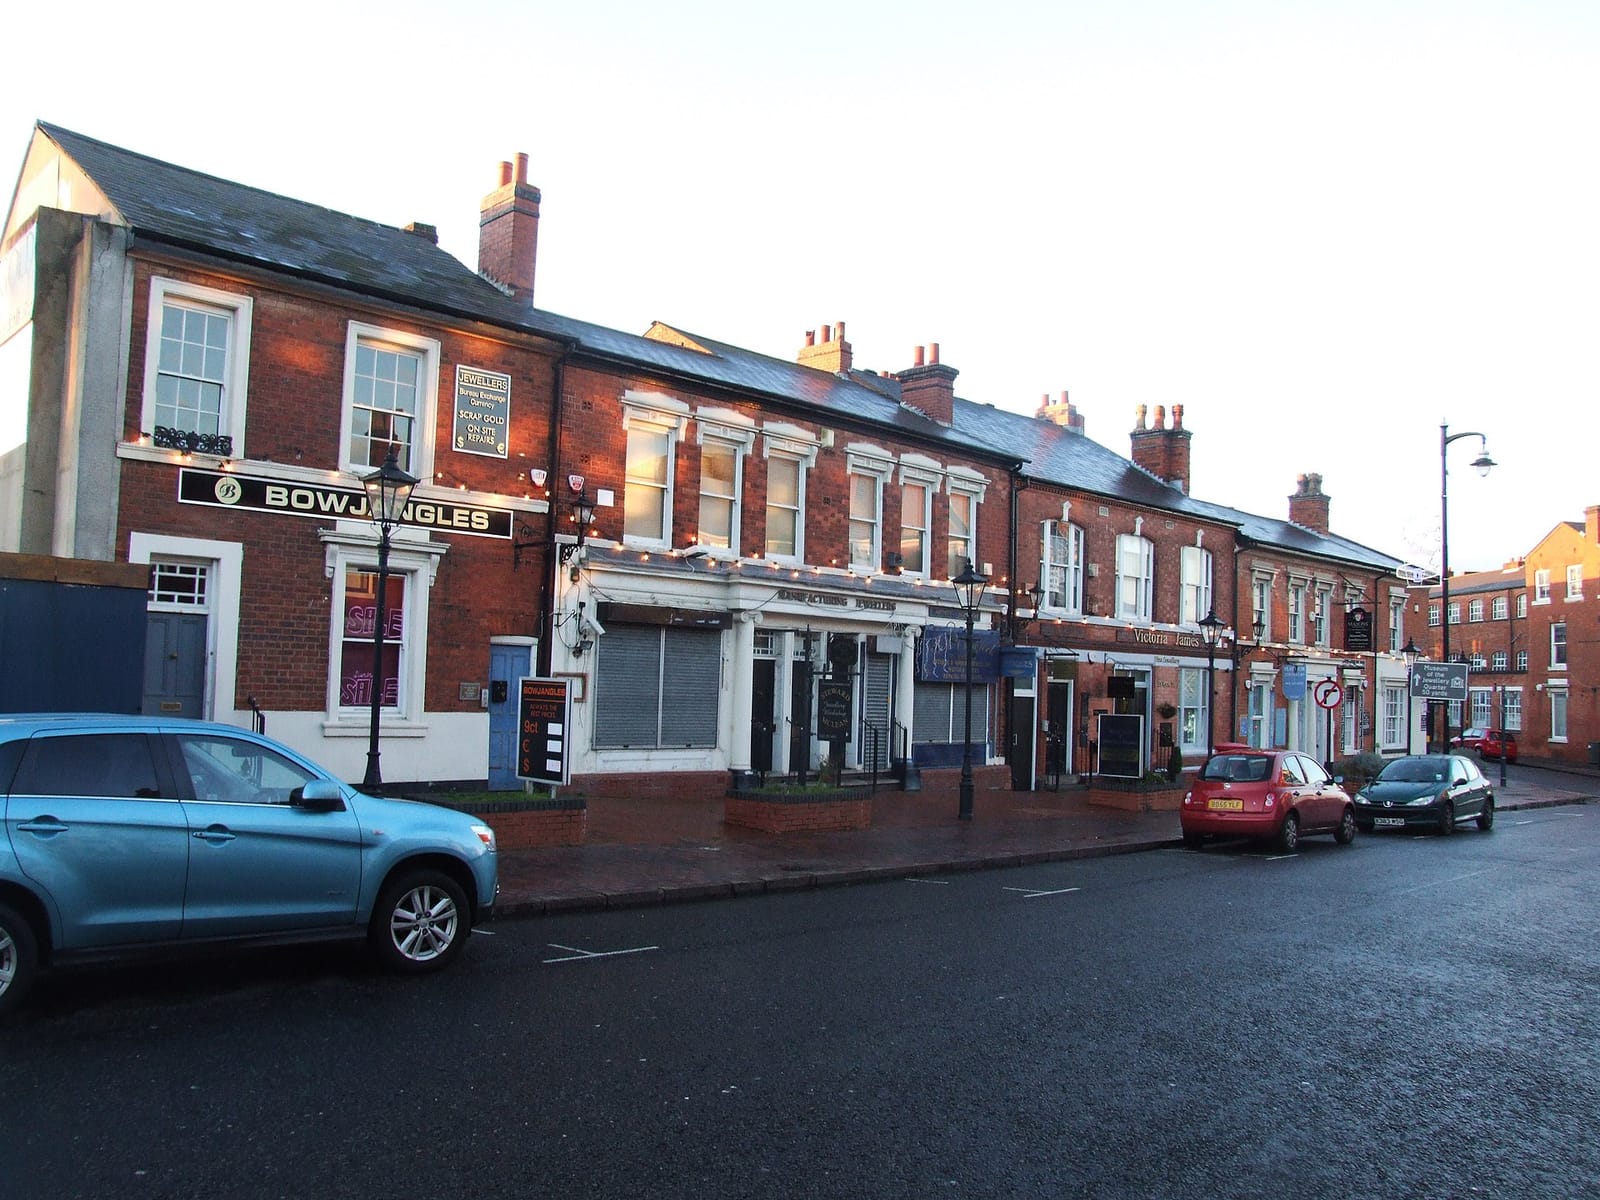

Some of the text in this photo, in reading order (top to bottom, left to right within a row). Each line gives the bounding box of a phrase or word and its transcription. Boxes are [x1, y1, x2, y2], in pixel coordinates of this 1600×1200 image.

[459, 373, 507, 390] JEWELLERS
[460, 387, 506, 404] Bureau Exchange
[470, 398, 495, 409] Currency
[459, 410, 504, 425] SCRAP GOLD
[467, 424, 496, 436] ON SITE
[467, 433, 495, 445] REPAIRS
[265, 485, 489, 530] BOWJNGLES
[778, 589, 897, 610] MANUFACTURING JEWELLERS
[1134, 628, 1200, 648] Victoria James
[1423, 664, 1449, 672] Museum
[1422, 677, 1450, 685] Jewellery
[341, 676, 398, 706] SAE
[523, 686, 566, 697] BOWJANGLES
[524, 719, 539, 734] 9ct
